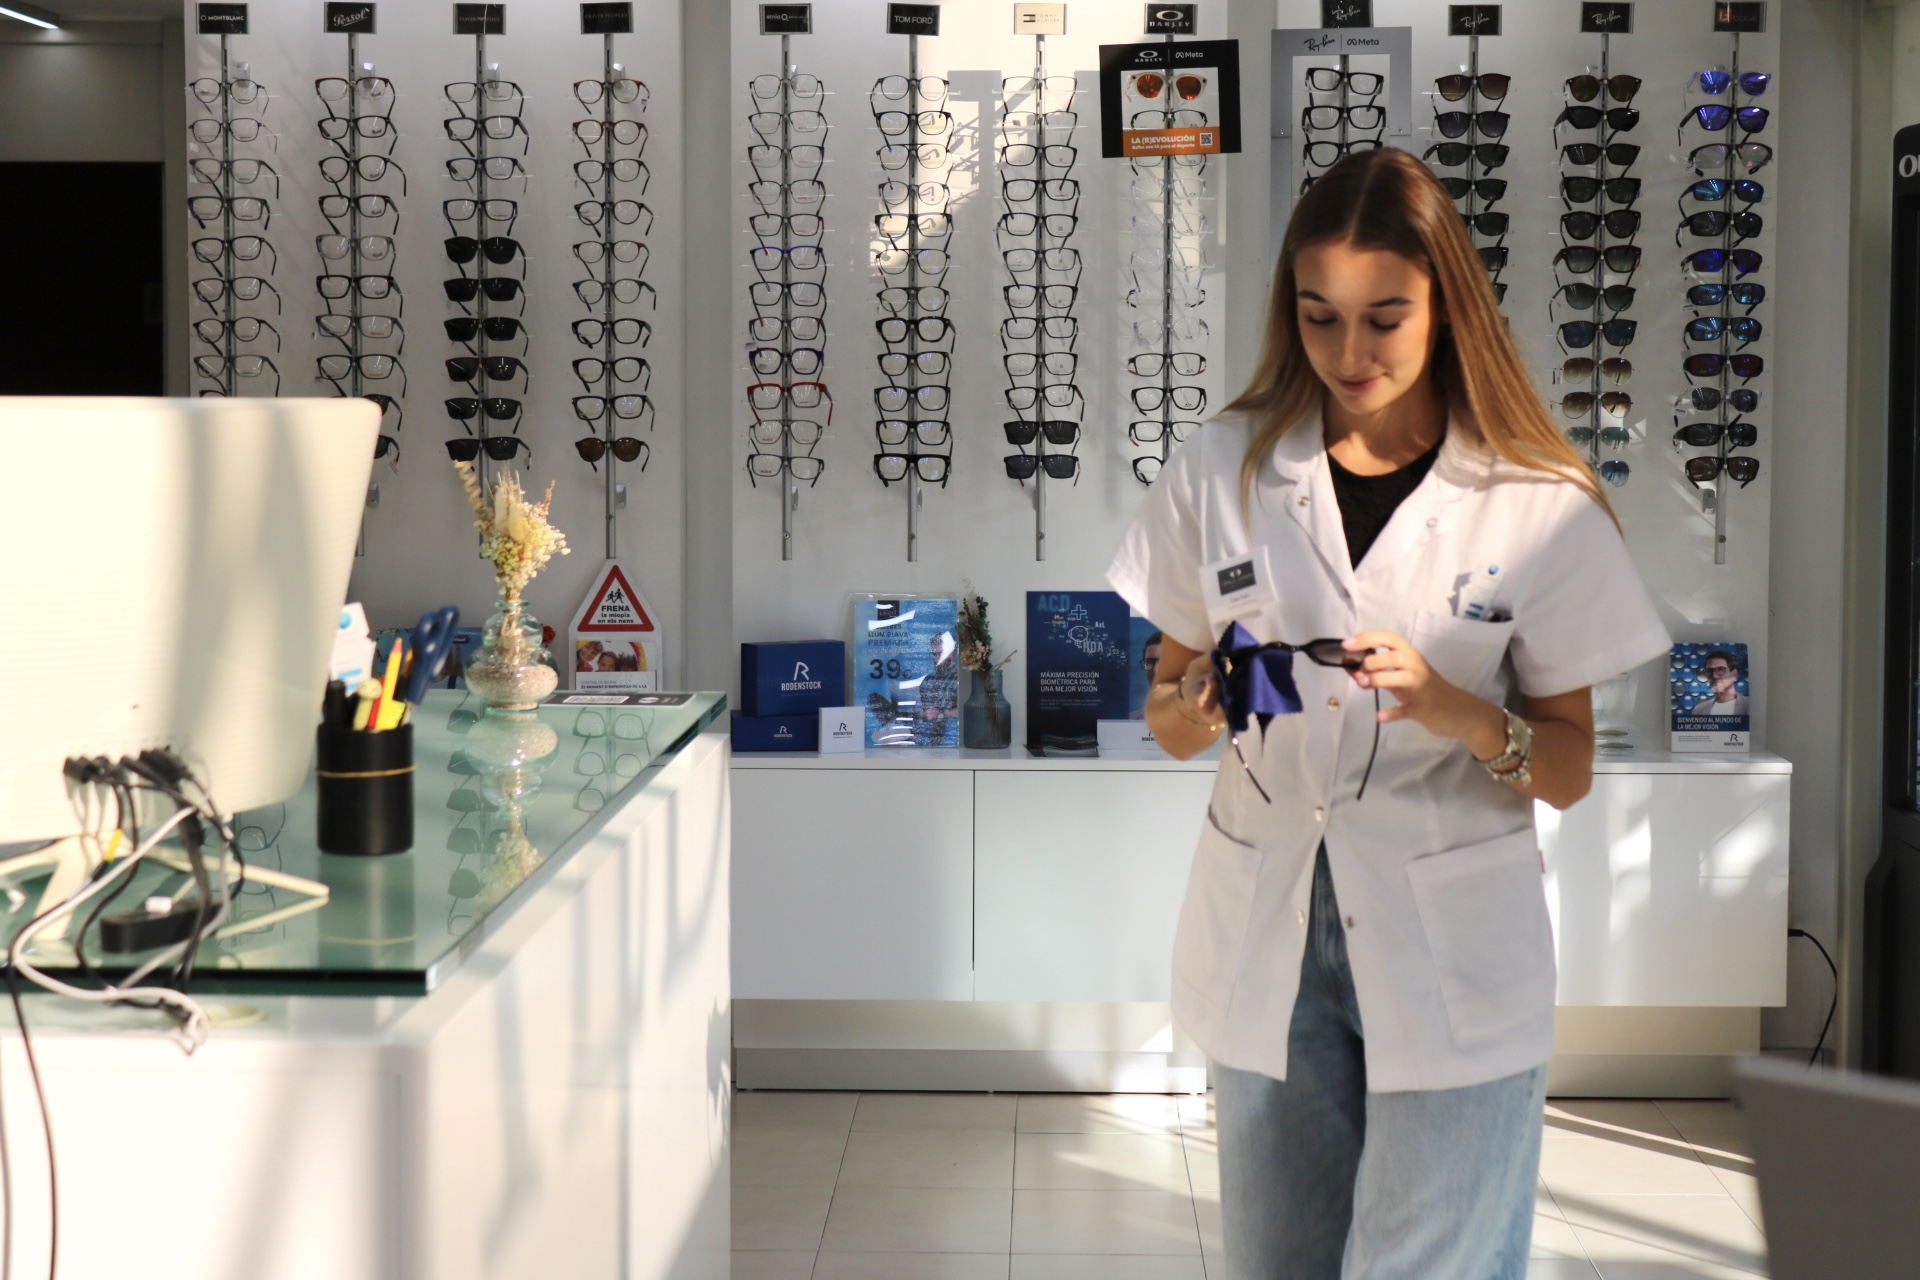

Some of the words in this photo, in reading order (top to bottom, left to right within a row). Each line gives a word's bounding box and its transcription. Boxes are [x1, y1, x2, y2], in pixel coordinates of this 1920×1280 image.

[333, 9, 367, 26] Persol
[1332, 6, 1360, 20] Ray-Ban
[1592, 10, 1620, 25] Ray-Ban
[1460, 14, 1489, 28] Ray-Ban
[1304, 34, 1335, 51] Ray-Ban
[1142, 134, 1195, 144] (R)EVOLUCIÓN
[1038, 594, 1070, 612] ACD
[782, 681, 822, 691] RODENSTOCK
